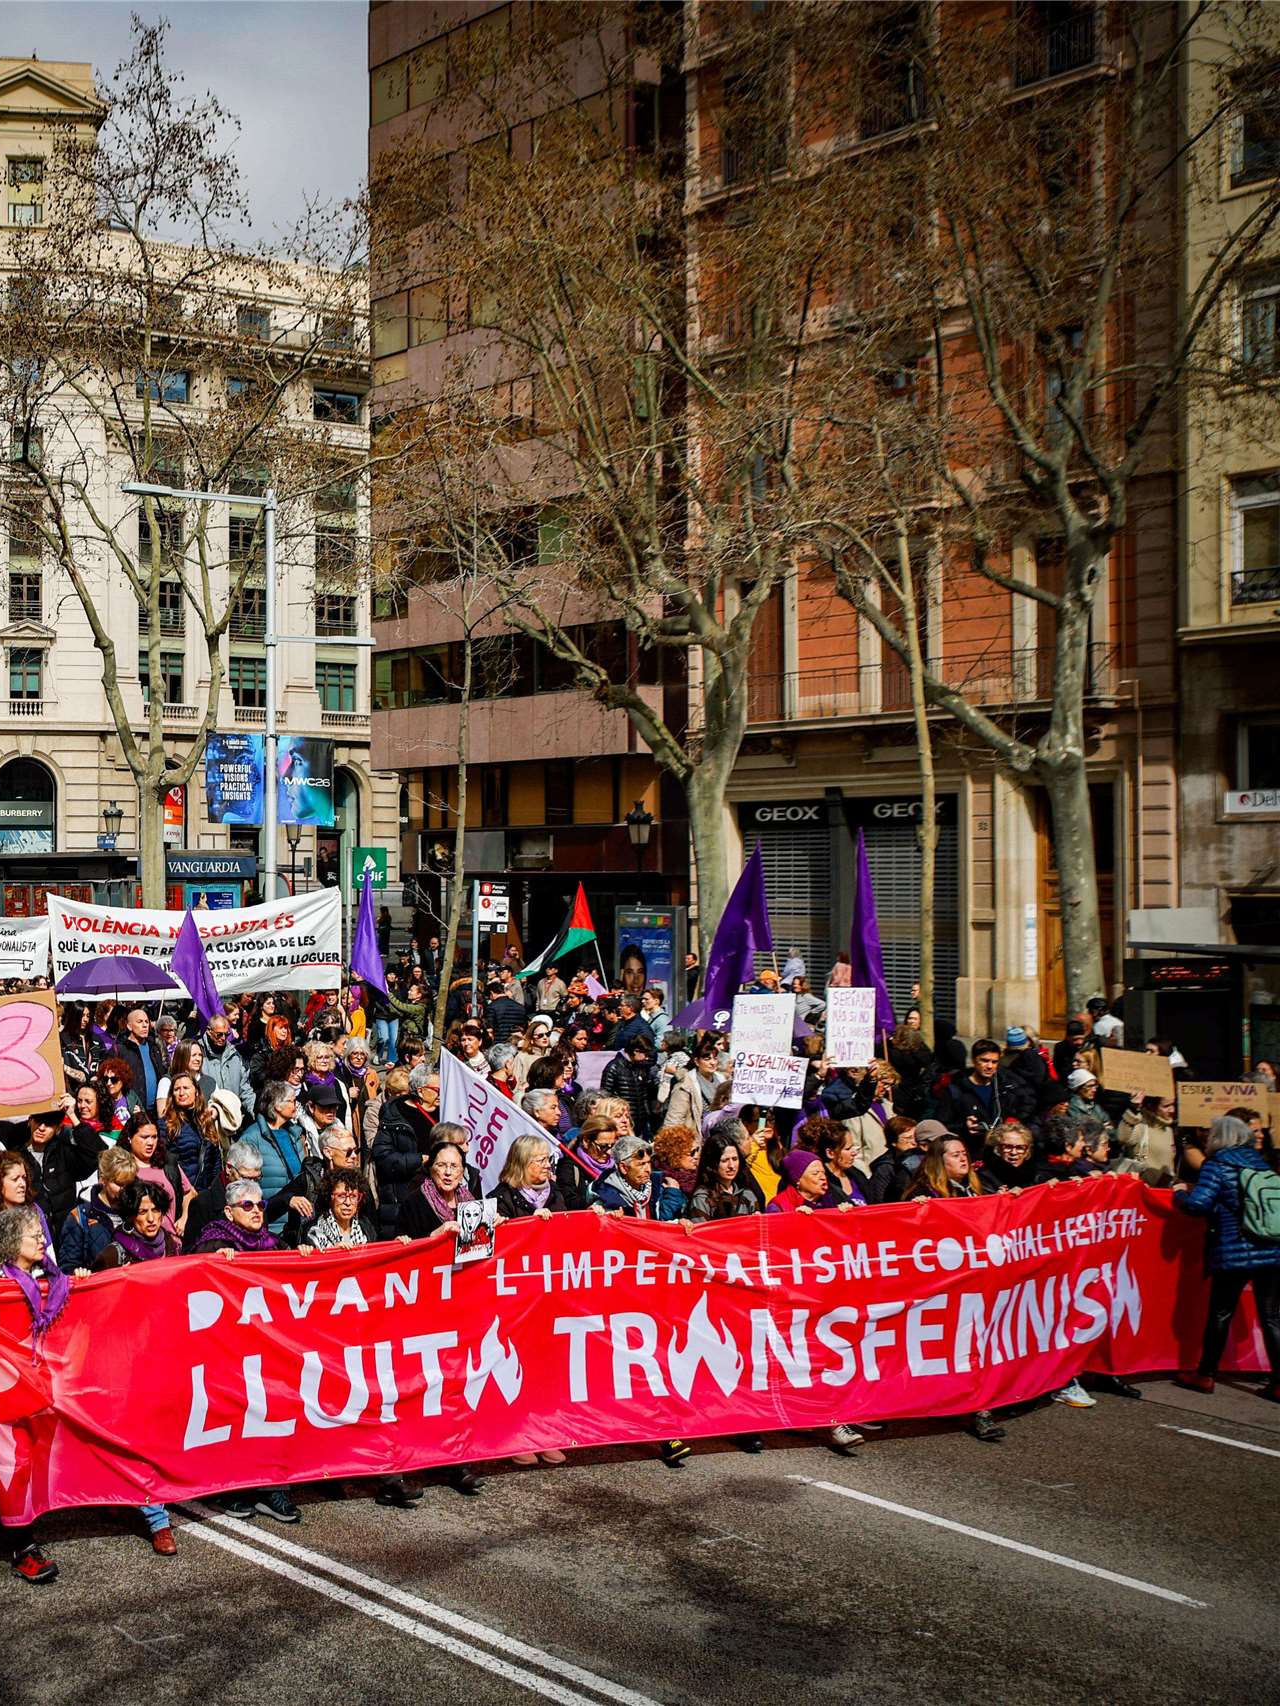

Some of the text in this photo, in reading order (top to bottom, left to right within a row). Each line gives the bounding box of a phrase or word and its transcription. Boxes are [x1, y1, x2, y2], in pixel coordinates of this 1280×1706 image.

[220, 764, 252, 773] POWERFUL
[224, 774, 248, 782] VISIONS
[284, 777, 331, 787] MWC26
[220, 783, 252, 791] PRACTICAL
[222, 791, 251, 800] INSIGHTS
[0, 809, 42, 817] BURBERRY
[755, 806, 819, 822] GEOX
[168, 861, 241, 873] VANGUARDIA
[61, 912, 296, 938] VIOLÈNCIA MSCLISTA ÉS
[58, 938, 78, 953] QUÈ
[82, 941, 96, 954] LA
[143, 946, 158, 955] ET
[220, 938, 276, 953] CUSTÒDIA
[280, 937, 295, 947] DE
[298, 935, 317, 946] LES
[276, 955, 289, 966] EL
[290, 951, 341, 965] LLOGUER
[859, 1010, 870, 1023] NO
[789, 1075, 801, 1085] EL
[1181, 1085, 1257, 1095] ESTAR VIVA
[187, 1264, 464, 1332] DAVANT
[495, 1240, 900, 1296] L'IMPERIALISME
[912, 1223, 1051, 1273] COLONIAL
